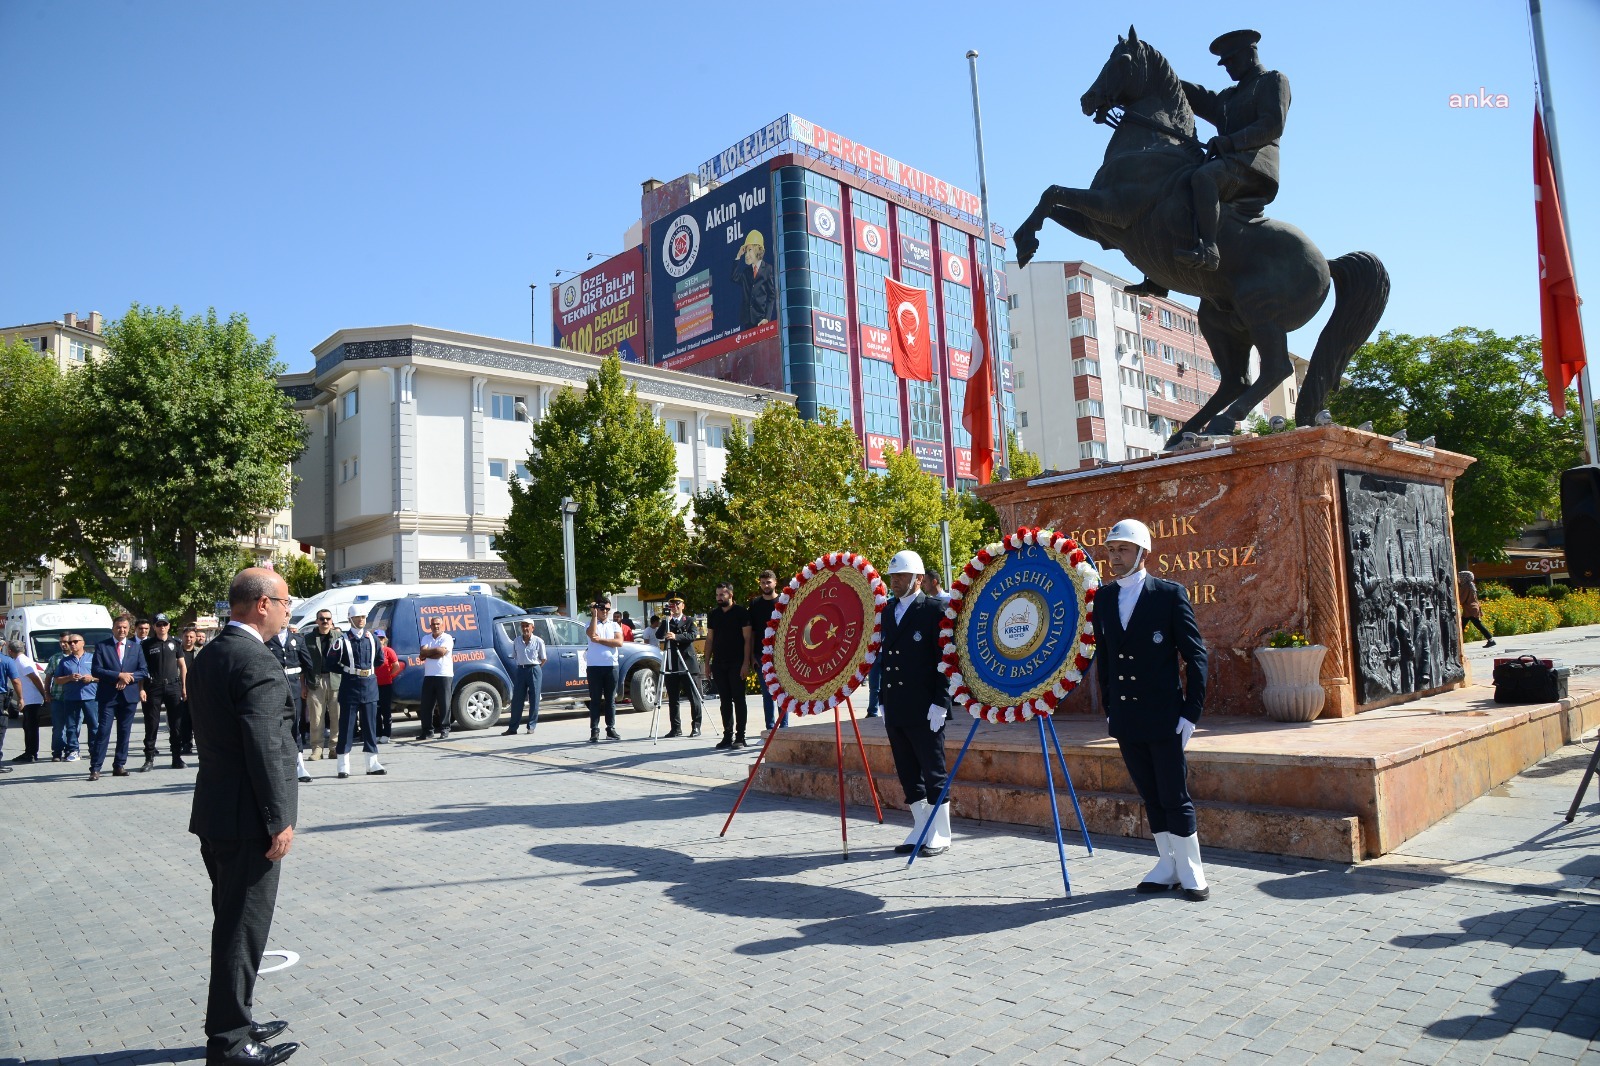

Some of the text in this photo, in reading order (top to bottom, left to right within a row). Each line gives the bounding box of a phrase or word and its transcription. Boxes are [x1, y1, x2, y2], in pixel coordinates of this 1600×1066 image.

[813, 125, 894, 180] PERGEL
[899, 162, 948, 203] KURS
[705, 186, 766, 232] Aklın Yolu
[726, 219, 744, 244] BİL
[582, 272, 607, 292] ÖZEL
[582, 271, 635, 304] OSB BİLİM
[684, 277, 699, 288] STEM
[562, 281, 635, 326] TEKNİK KOLEJİ
[595, 301, 630, 332] DEVLET
[595, 314, 638, 352] DESTEKLİ
[819, 316, 842, 332] TUS
[866, 342, 891, 353] GRUPLAR
[1158, 546, 1257, 575] ŞARTSIZ
[991, 570, 1055, 600] KIRŞEHİR
[420, 603, 472, 615] KIRŞEHİR
[786, 624, 812, 678] KIRŞEHİR
[977, 600, 1065, 678] BELEDİYE BAŞKANLIĞI
[407, 656, 416, 666] İL
